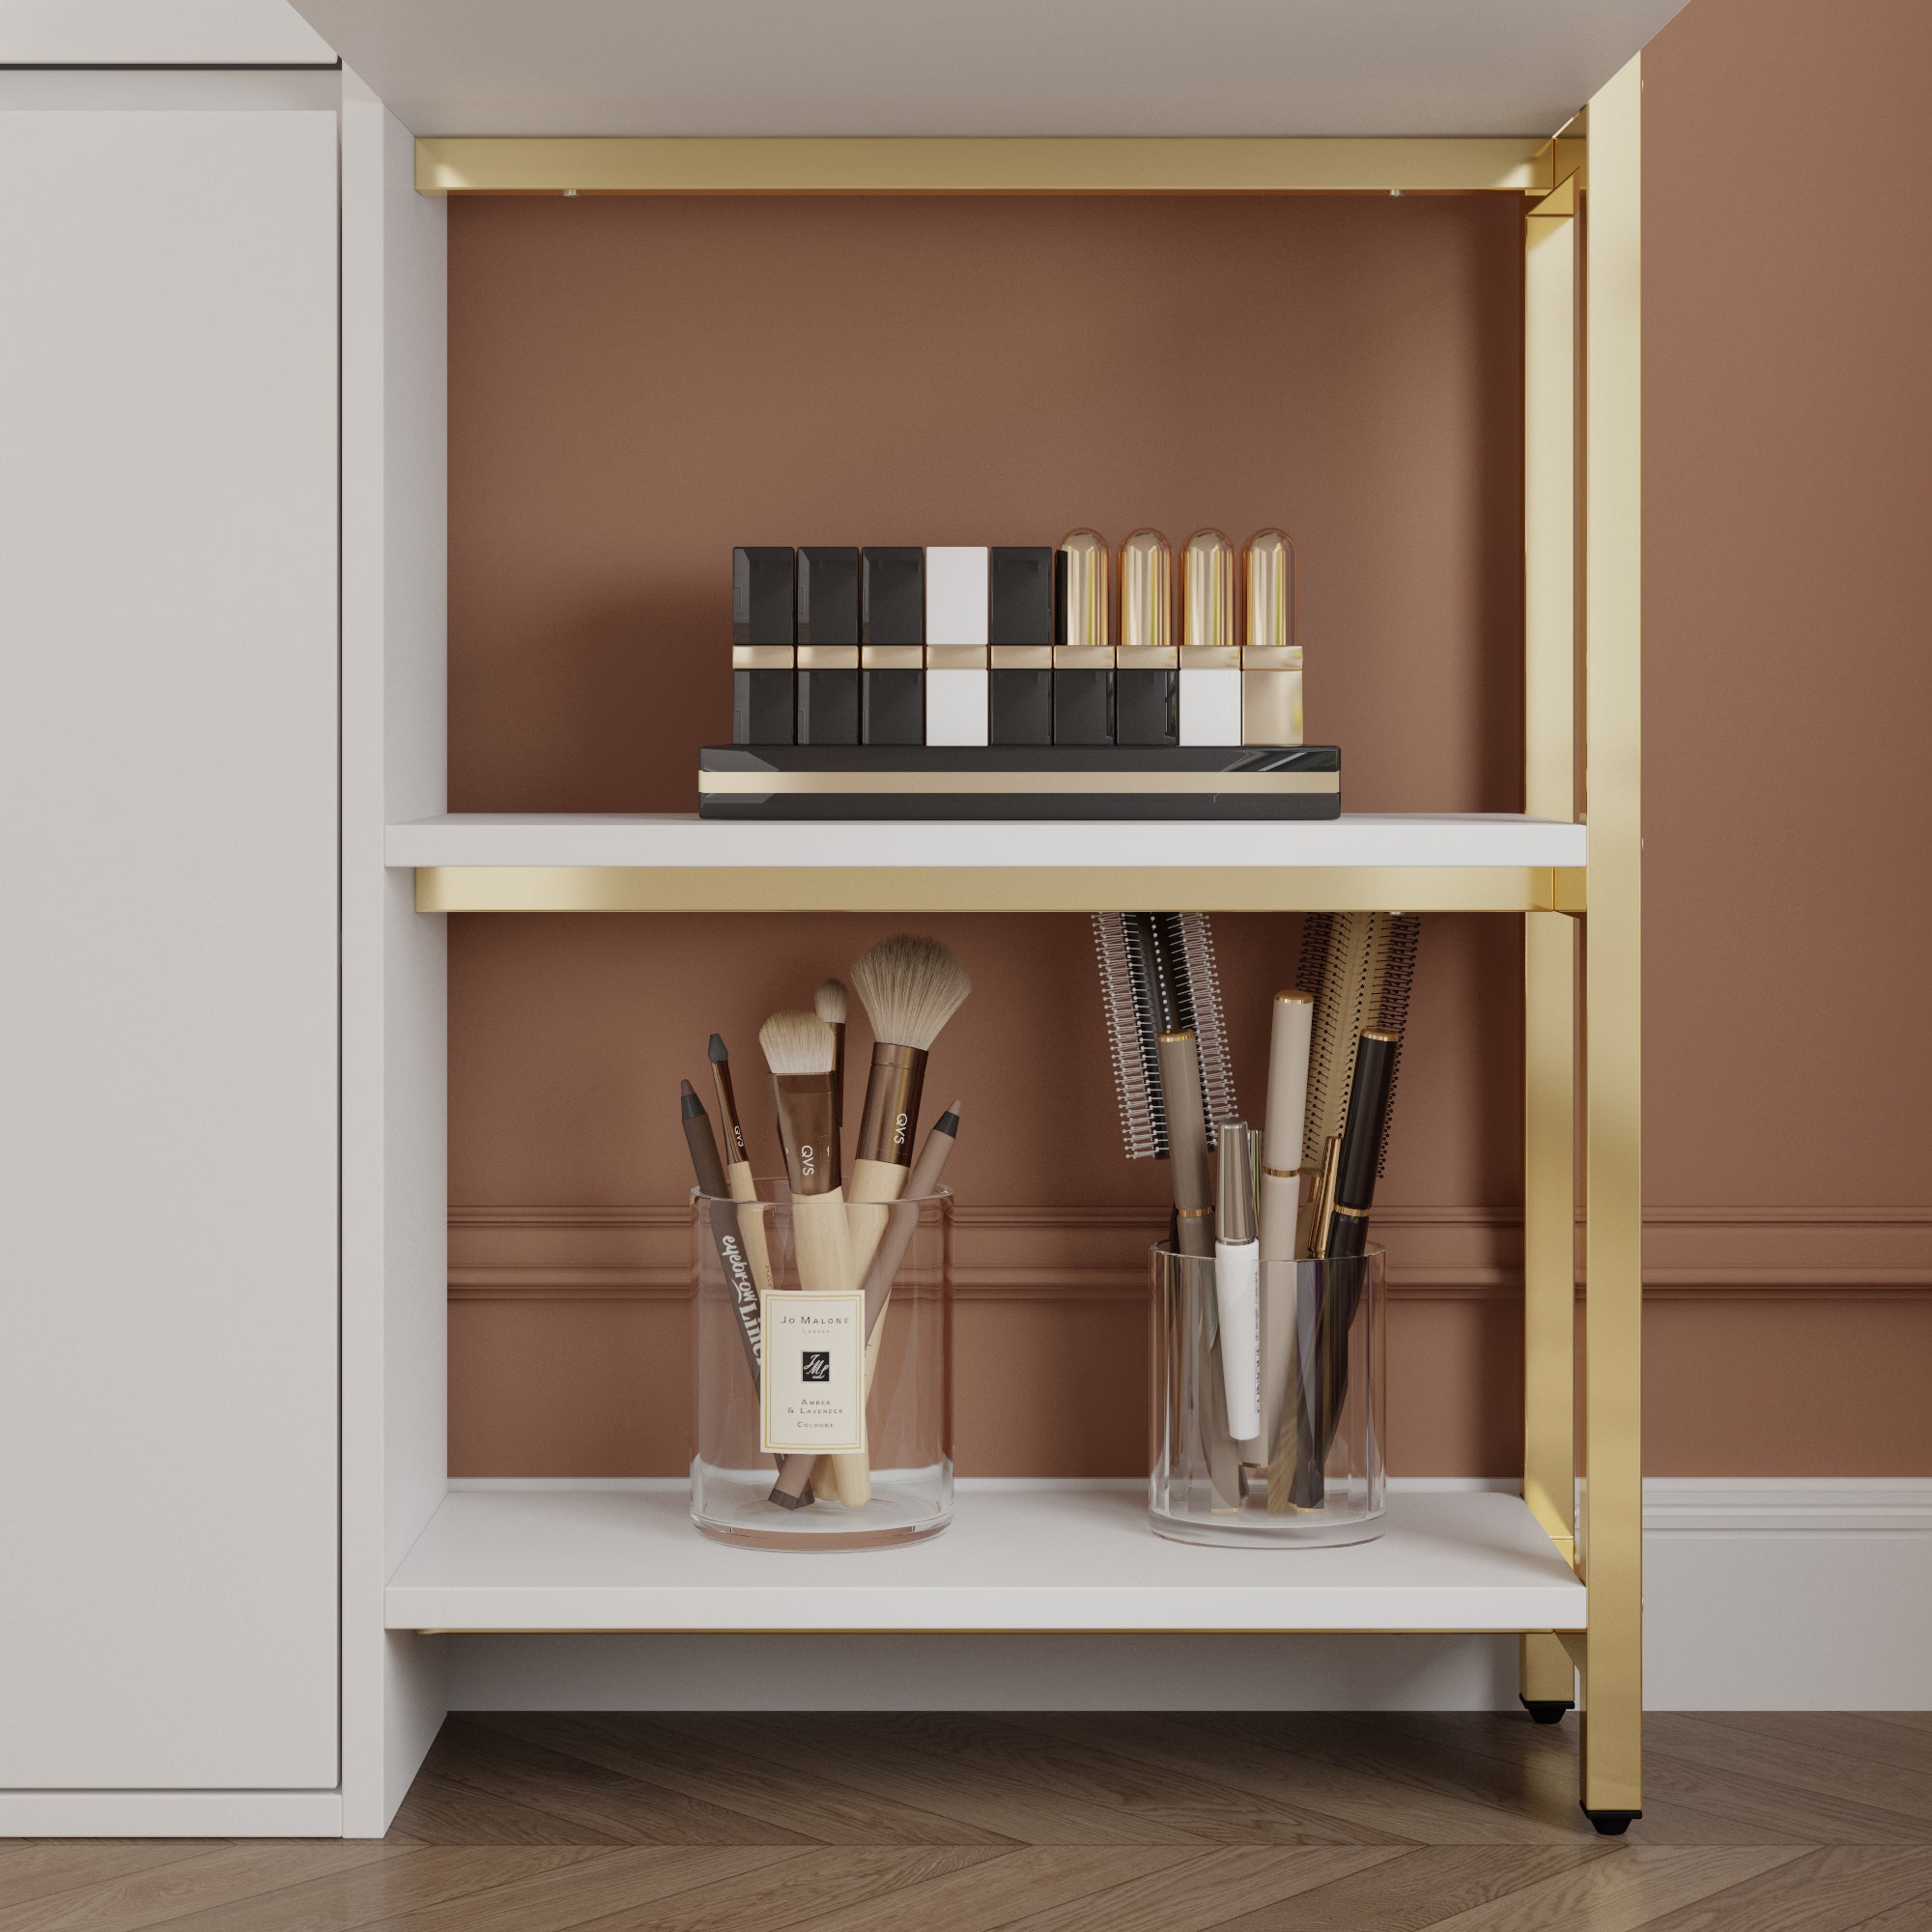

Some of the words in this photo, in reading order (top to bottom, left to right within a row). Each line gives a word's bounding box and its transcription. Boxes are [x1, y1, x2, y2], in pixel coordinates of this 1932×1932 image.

[893, 1113, 908, 1145] QVS
[801, 1145, 814, 1176] QVS
[722, 1235, 758, 1304] eyebrow
[801, 1316, 850, 1324] MALONE
